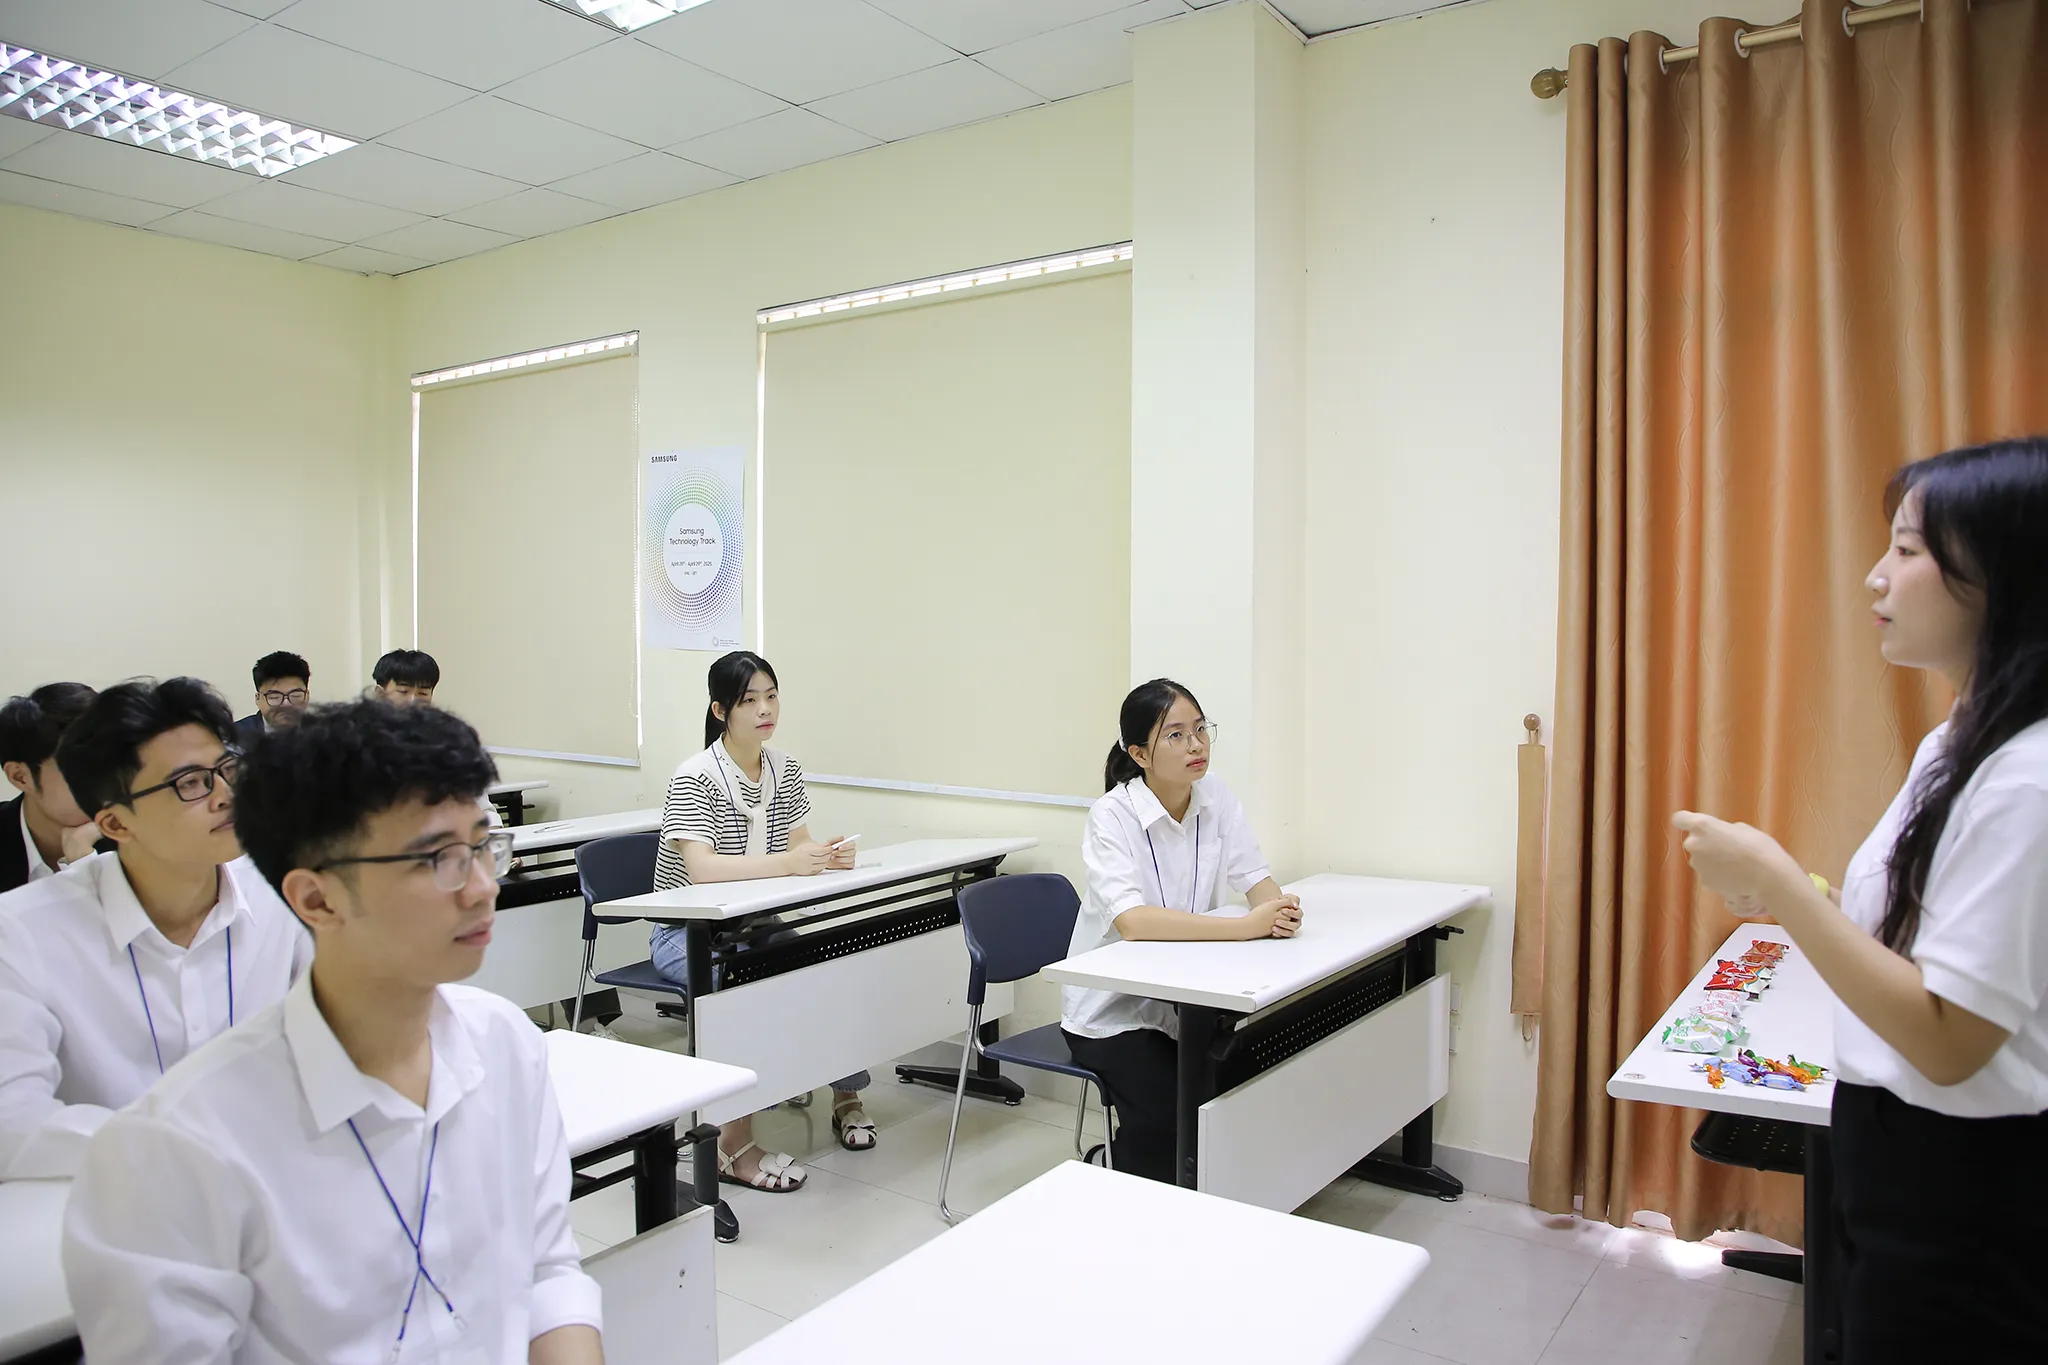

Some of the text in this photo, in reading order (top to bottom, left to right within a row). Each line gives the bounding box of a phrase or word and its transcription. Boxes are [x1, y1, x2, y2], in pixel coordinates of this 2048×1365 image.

[651, 455, 678, 464] SAMSUNG
[679, 528, 705, 536] Samsung
[669, 538, 699, 546] Technology
